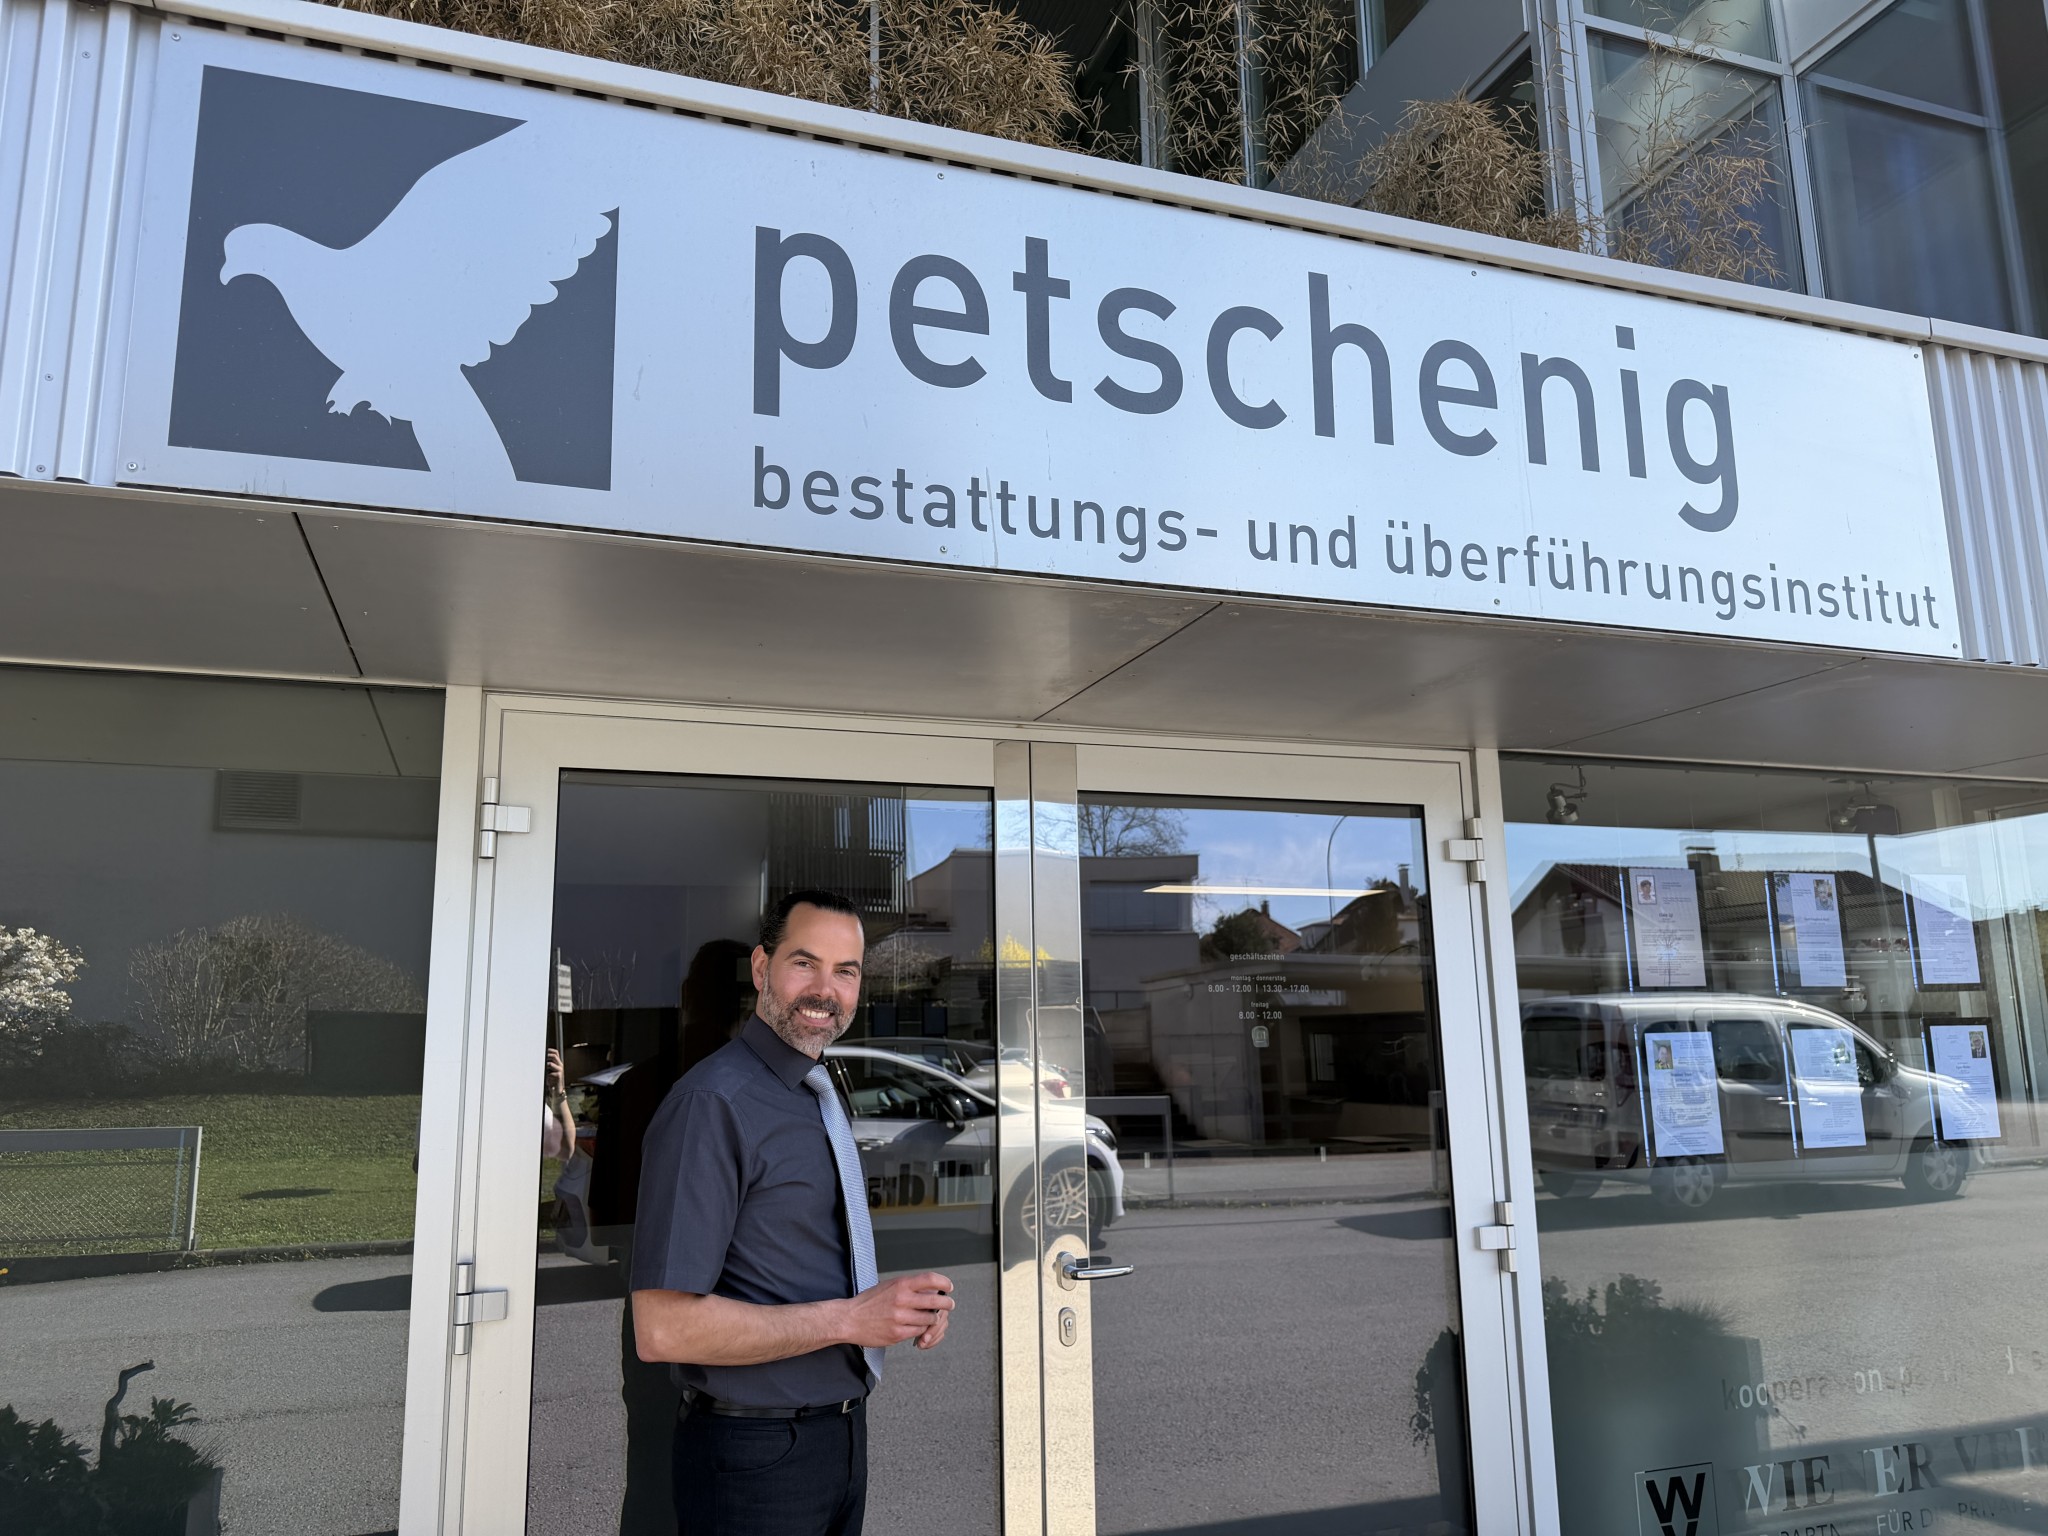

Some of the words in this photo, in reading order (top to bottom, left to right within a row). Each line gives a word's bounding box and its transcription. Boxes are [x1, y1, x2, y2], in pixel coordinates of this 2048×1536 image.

[753, 226, 1739, 532] petschenig
[753, 446, 1217, 563] bestattungs-
[1247, 516, 1356, 569] und
[1385, 520, 1939, 629] überführungsinstitut
[1229, 952, 1285, 962] geschäftszeiten
[1230, 975, 1251, 983] montag
[1255, 974, 1287, 983] donnerstag
[1208, 984, 1224, 993] 8.00
[1231, 984, 1252, 993] 12.00
[1262, 984, 1283, 993] 13.30
[1290, 984, 1310, 993] 17.00
[1250, 1000, 1270, 1009] freitag
[1238, 1011, 1255, 1020] 8.00
[1262, 1011, 1283, 1020] 12.00
[1876, 1508, 1914, 1536] FÜR
